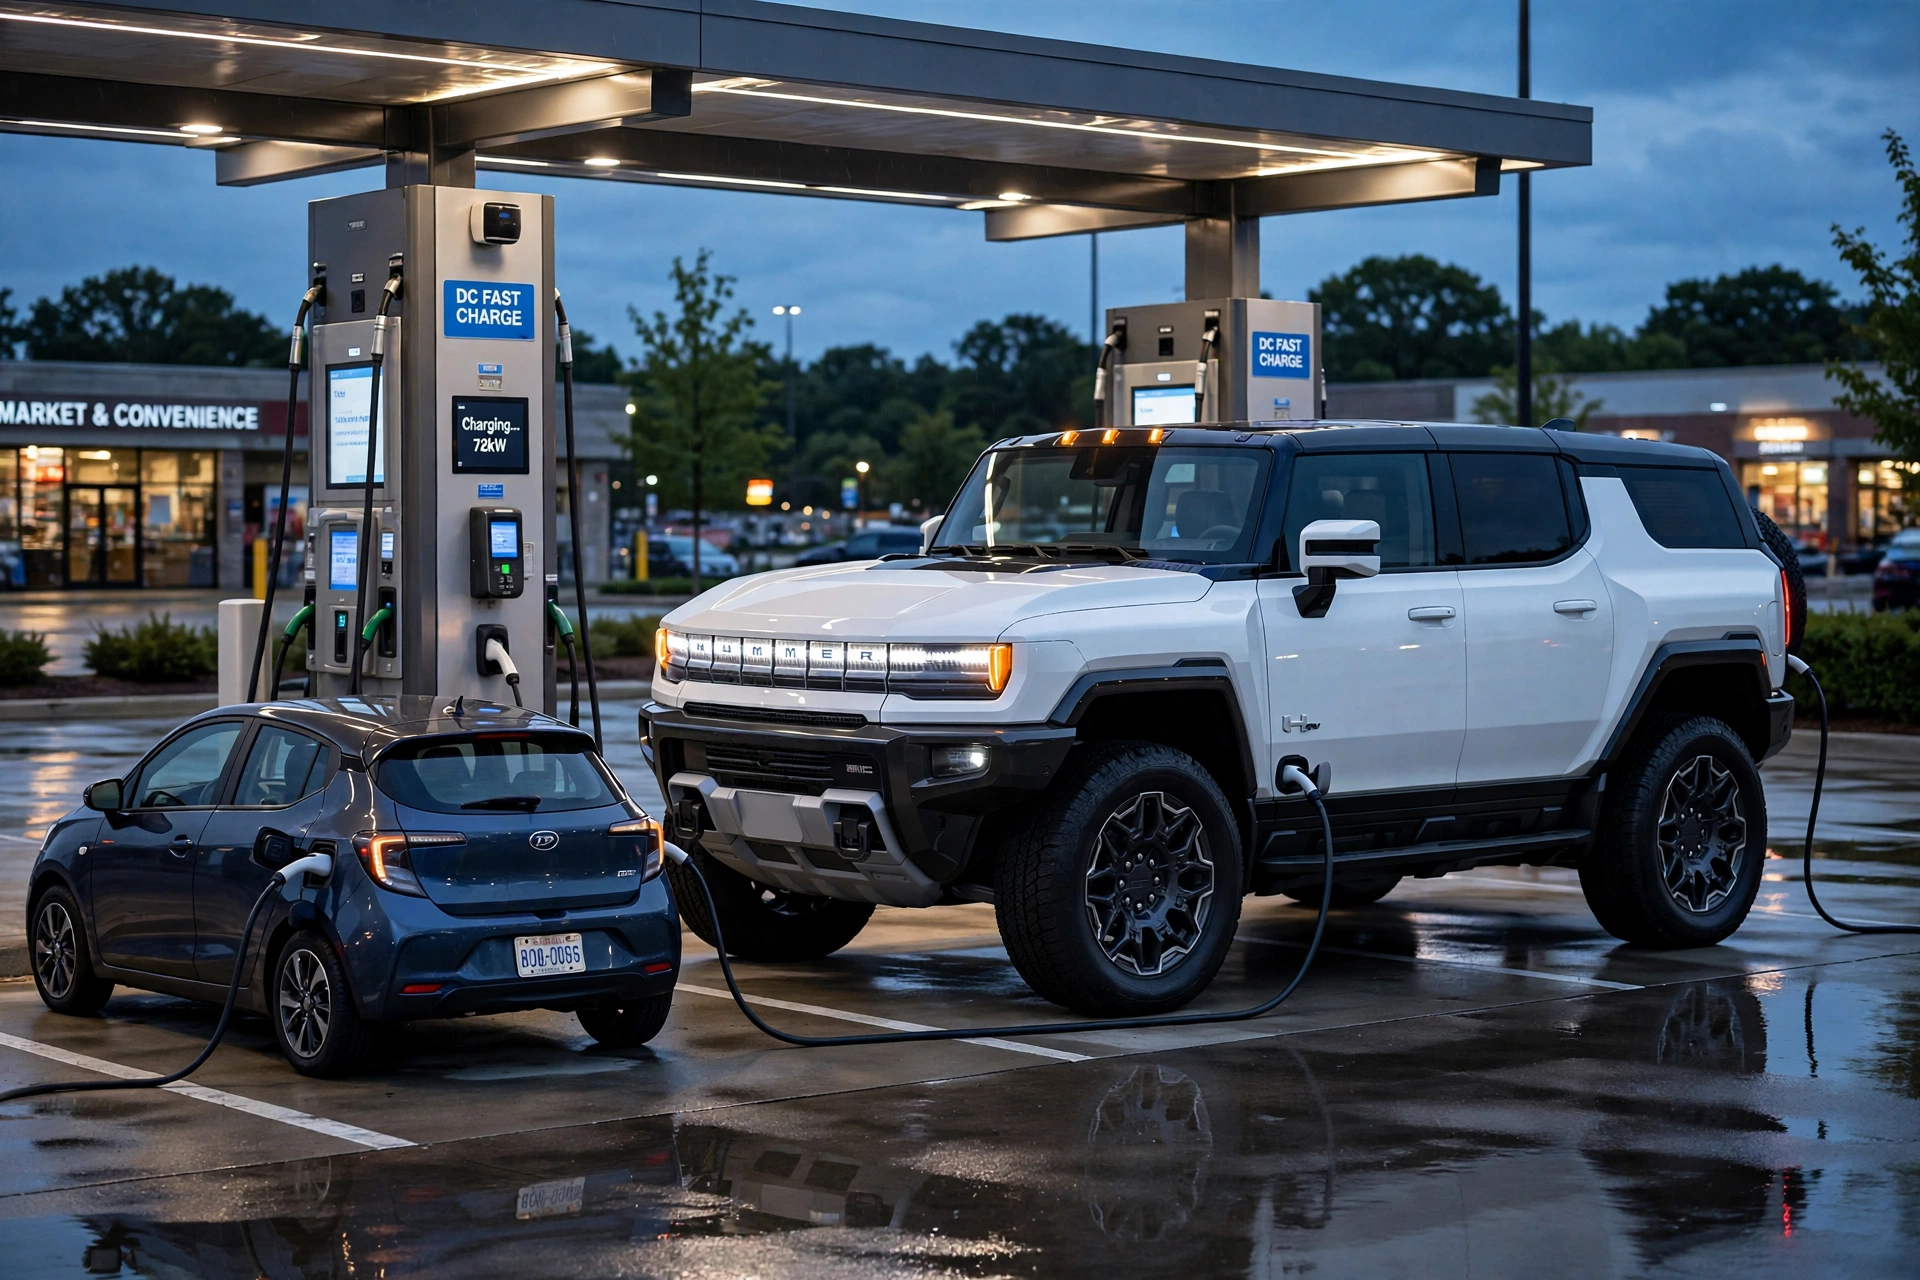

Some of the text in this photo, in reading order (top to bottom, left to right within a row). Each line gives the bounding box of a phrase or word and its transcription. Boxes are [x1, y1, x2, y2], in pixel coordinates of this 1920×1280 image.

[456, 287, 521, 306] DC FAST
[456, 307, 522, 326] CHARGE
[1259, 337, 1302, 352] DC FAST
[1259, 352, 1303, 368] CHARGE
[0, 400, 259, 430] MARKET & CONVENIENCE
[462, 416, 520, 435] Charging...
[472, 437, 507, 453] 72kW
[696, 642, 873, 661] HUMMER
